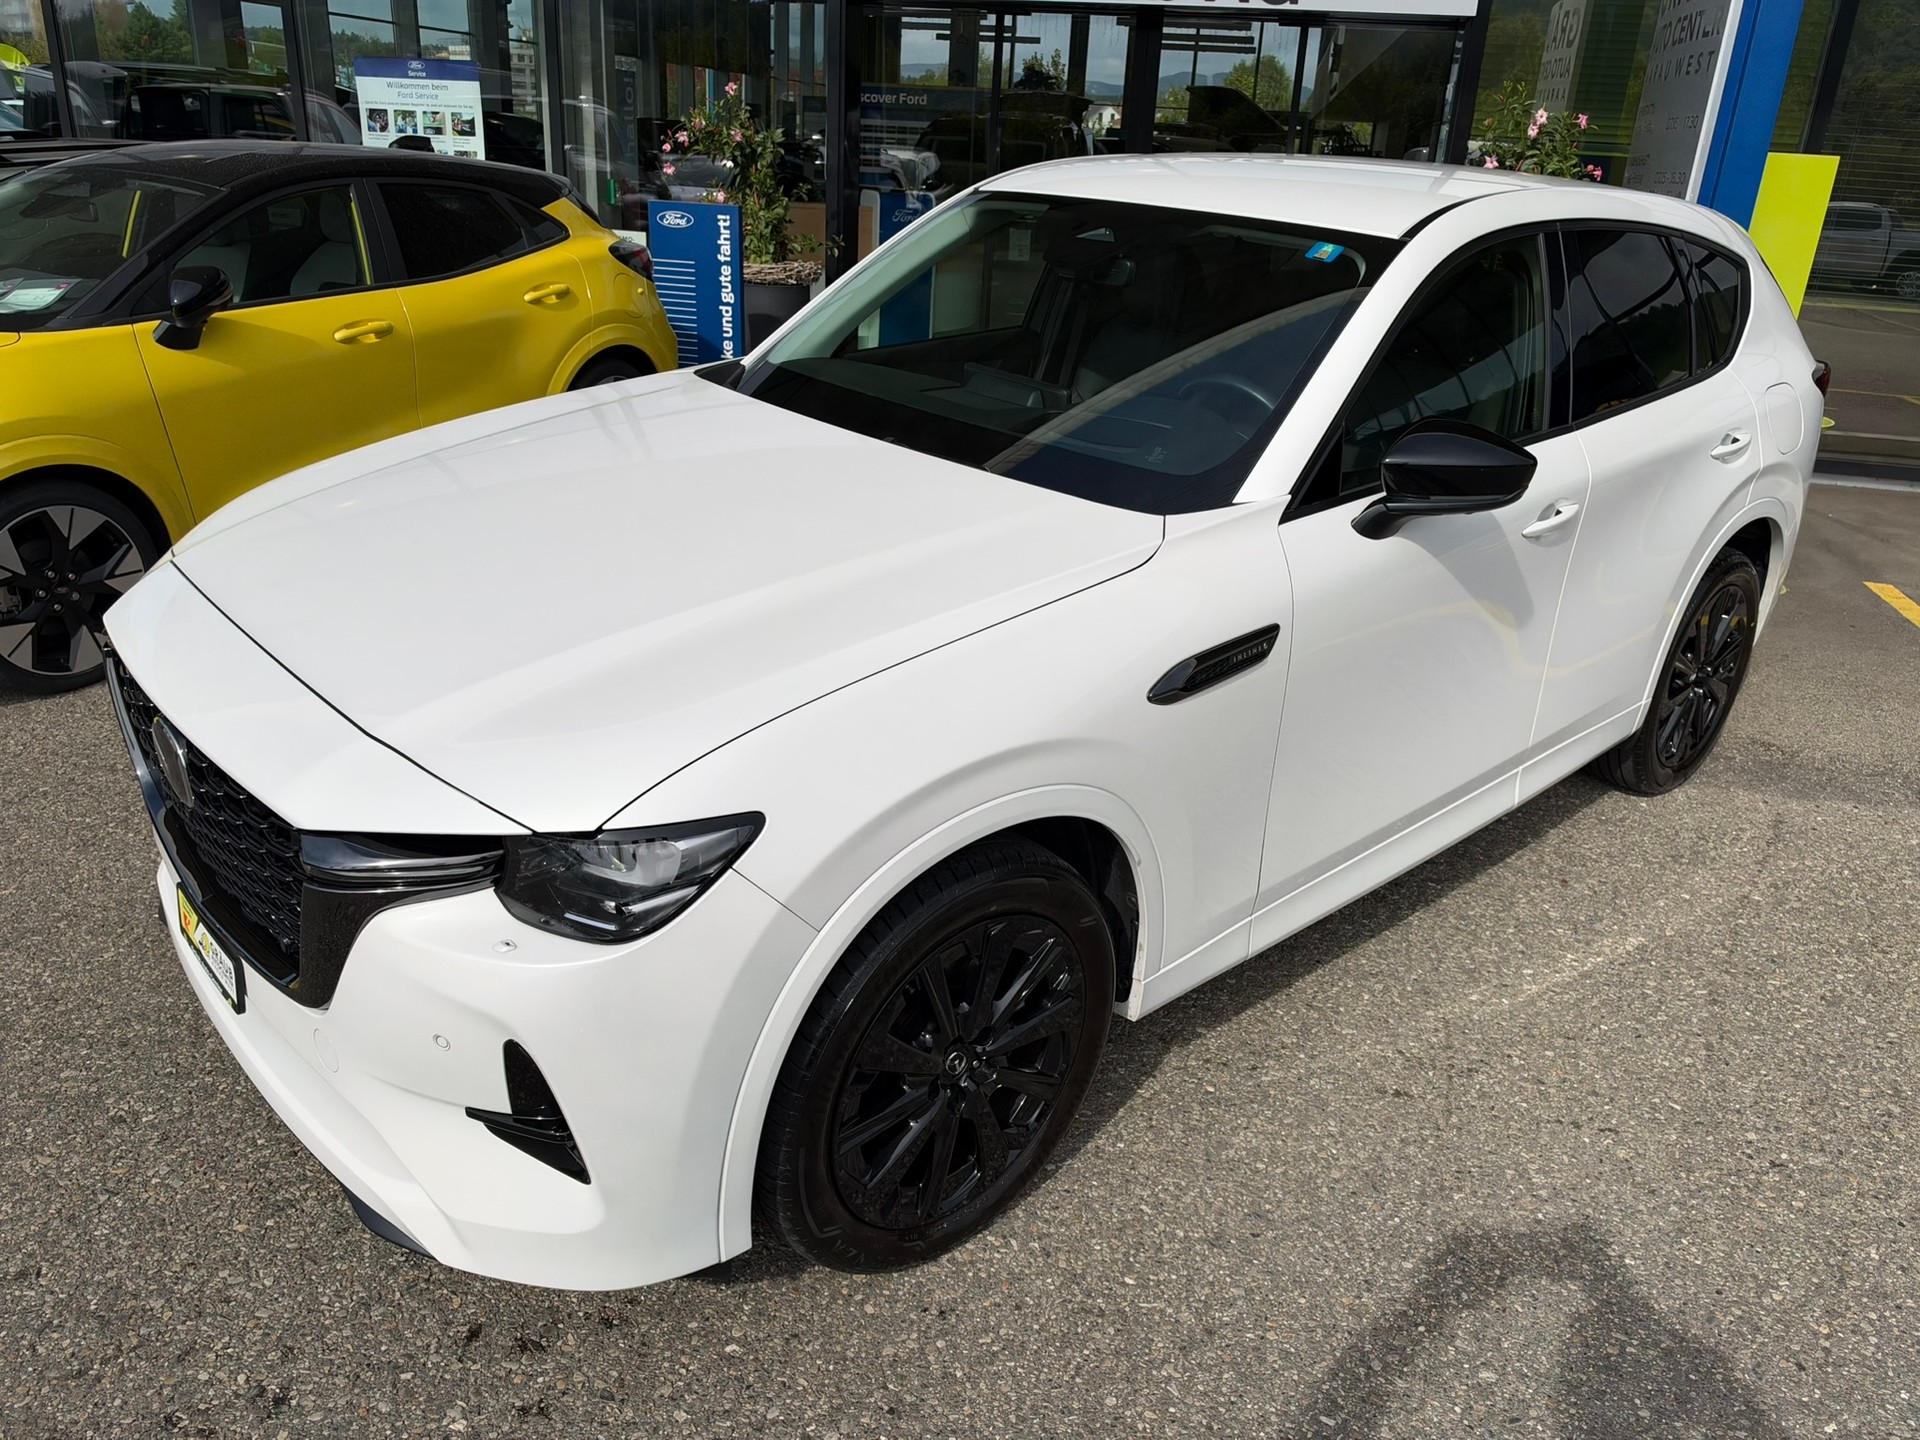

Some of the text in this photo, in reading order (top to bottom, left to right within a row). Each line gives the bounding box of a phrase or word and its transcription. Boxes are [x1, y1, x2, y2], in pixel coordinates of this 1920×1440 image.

[1674, 50, 1716, 78] WEST
[386, 81, 449, 91] Willkommen beim
[397, 91, 439, 100] Ford Service
[860, 93, 927, 105] scover Ford
[717, 214, 735, 359] ke und gute fahrt!
